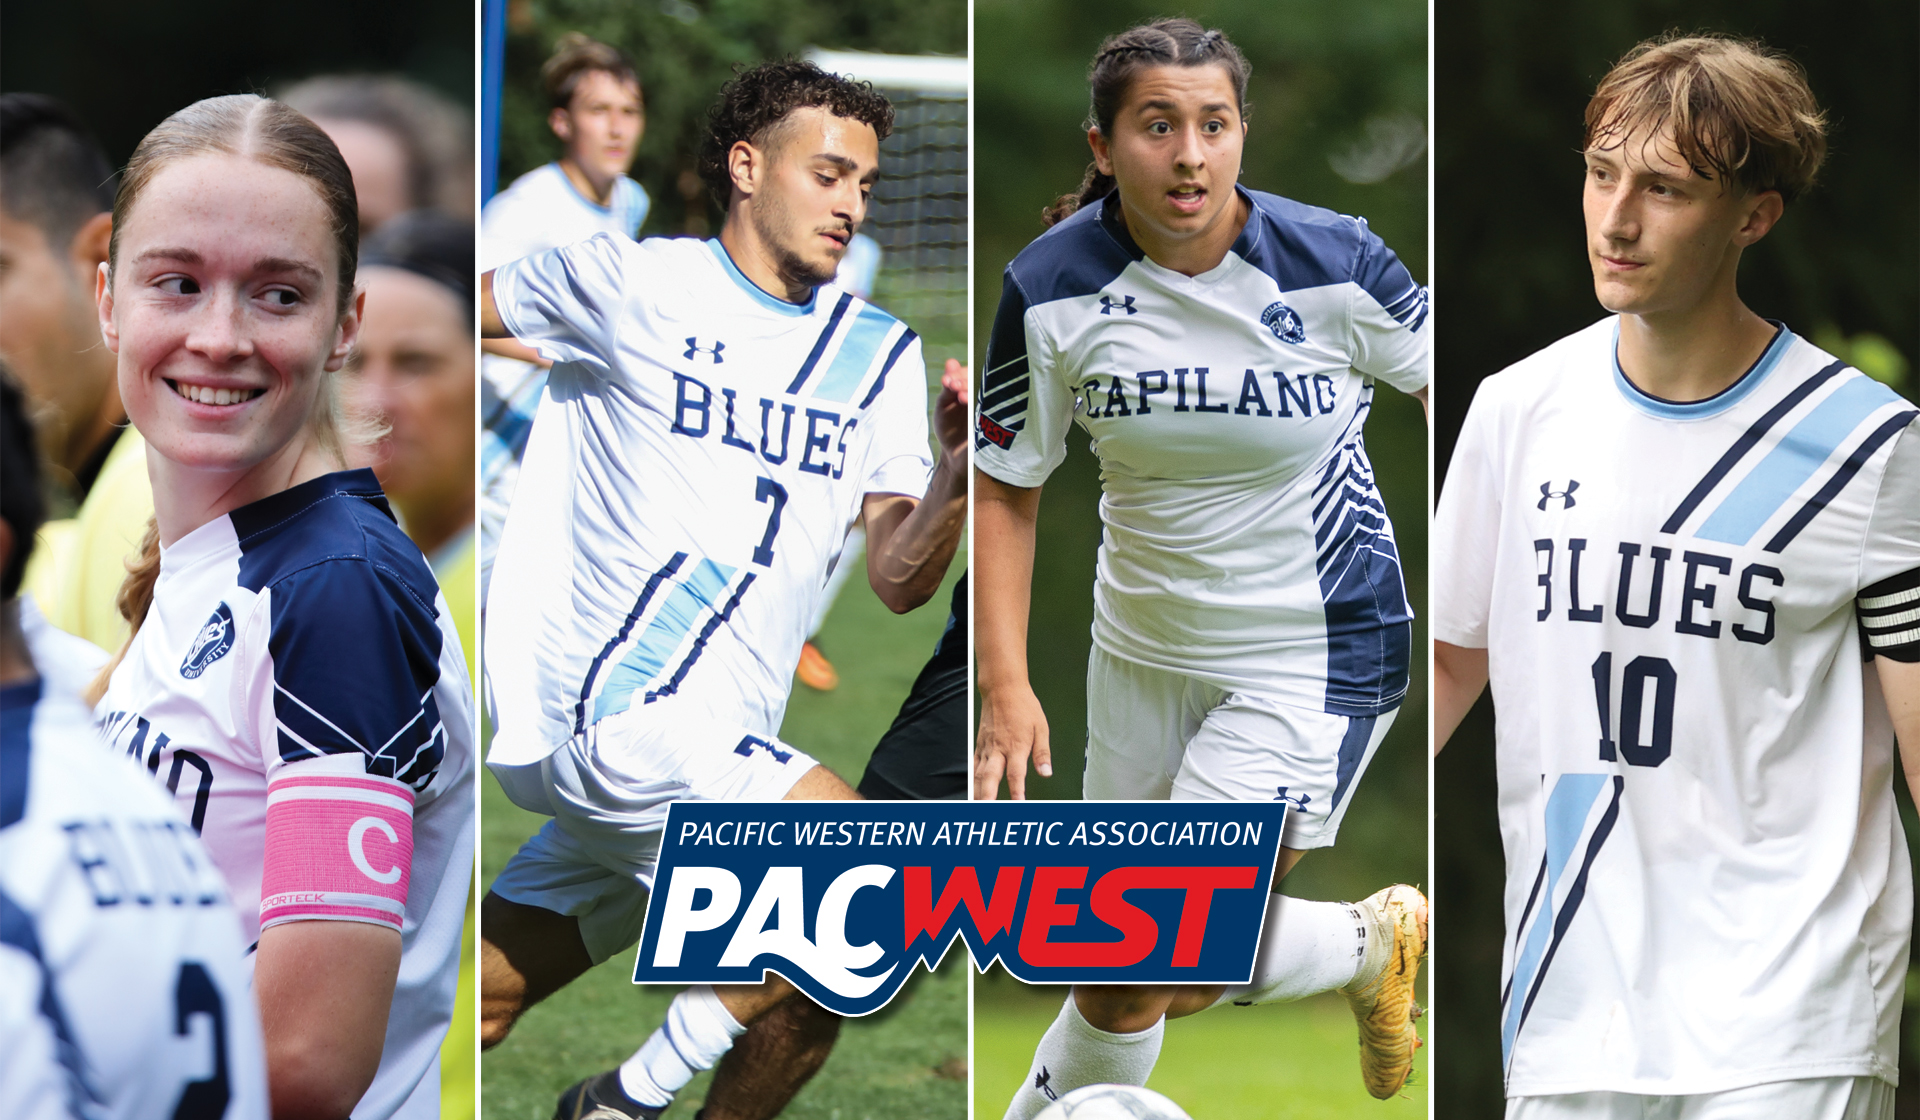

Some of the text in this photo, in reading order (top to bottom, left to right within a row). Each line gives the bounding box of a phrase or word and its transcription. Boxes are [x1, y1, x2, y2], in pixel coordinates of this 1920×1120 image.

[670, 371, 858, 480] BLUES
[1083, 367, 1337, 419] CAPILANO
[752, 475, 789, 568] 7
[1534, 538, 1785, 646] BLUES
[1591, 651, 1678, 768] 10
[347, 815, 402, 885] C
[262, 893, 325, 911] SPORTECK
